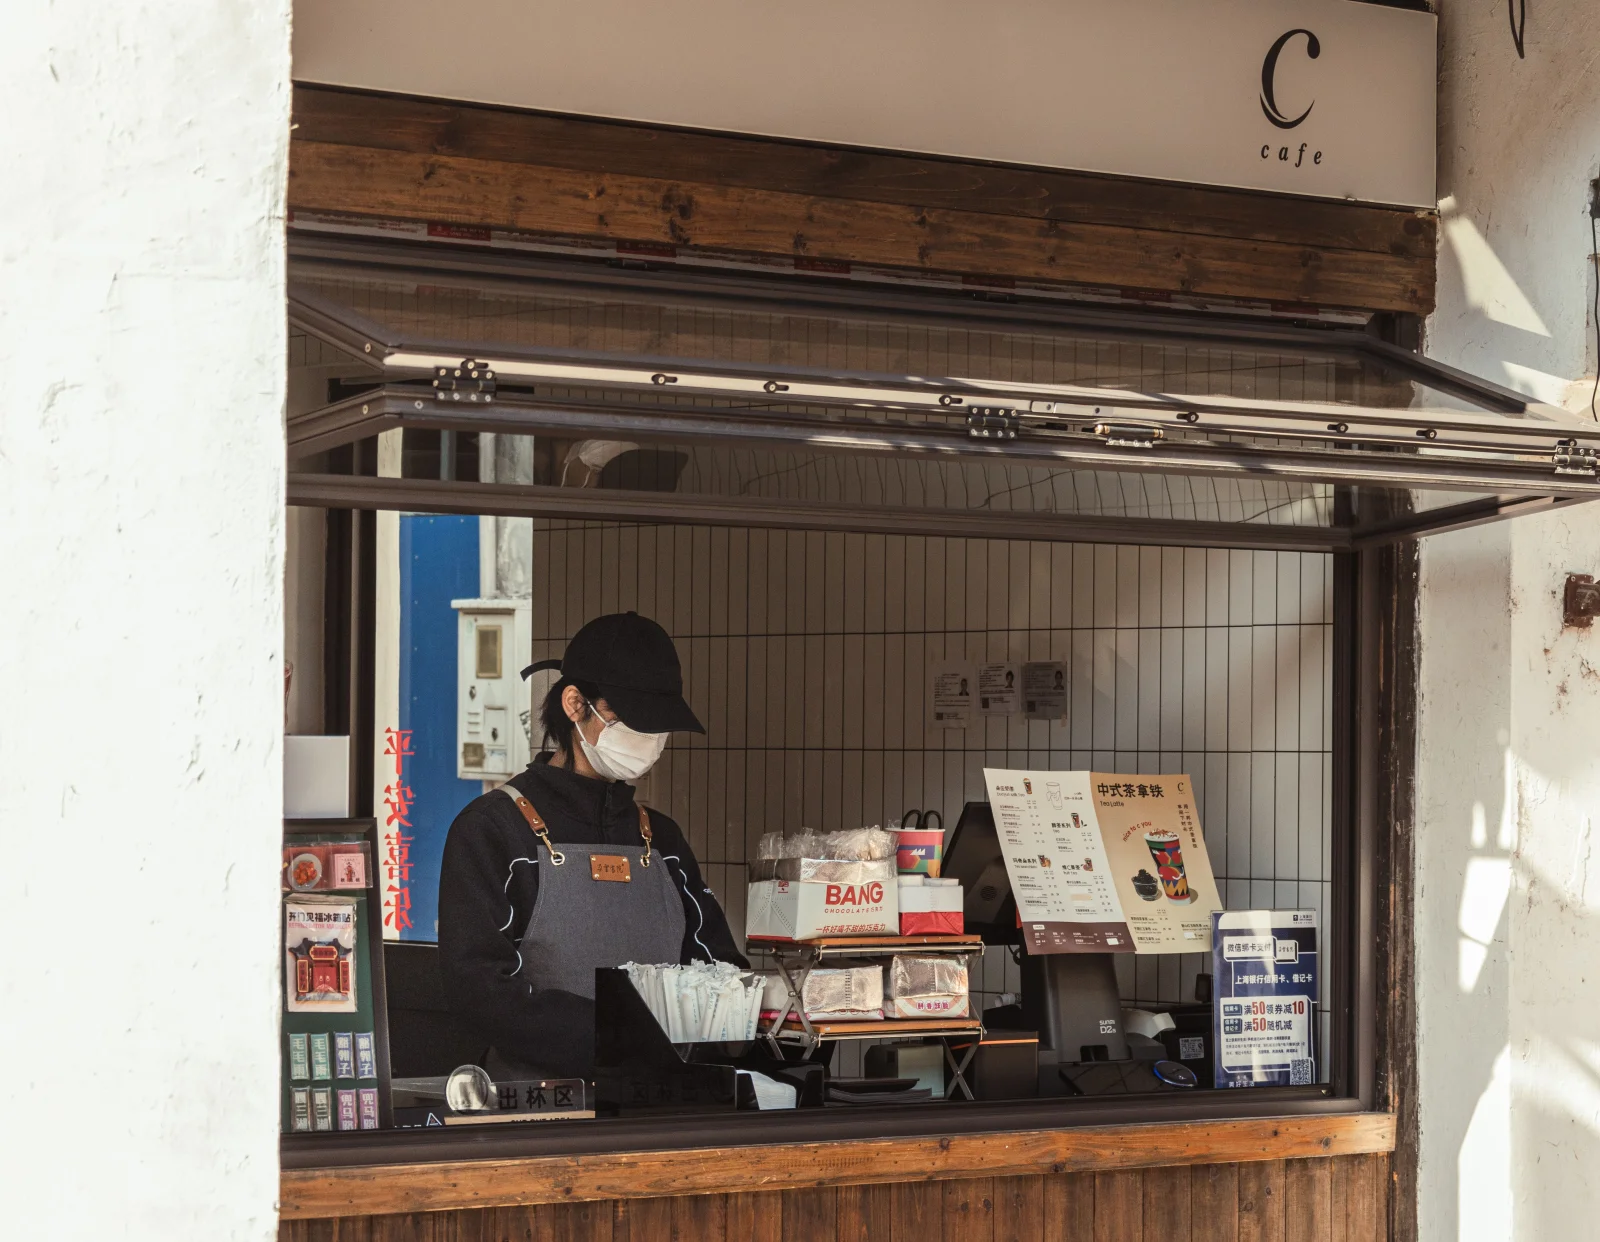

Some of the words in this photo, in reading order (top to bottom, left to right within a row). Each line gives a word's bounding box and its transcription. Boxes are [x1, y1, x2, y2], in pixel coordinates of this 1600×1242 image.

[1260, 29, 1321, 129] C
[1261, 143, 1322, 168] cafe
[1097, 783, 1164, 798] 中式茶拿铁
[1122, 830, 1132, 842] nice
[1141, 821, 1152, 829] you
[825, 882, 884, 905] BANG
[289, 912, 351, 923] 开门见福冰箱贴
[1227, 942, 1272, 953] 微信绑卡支付
[1244, 1001, 1305, 1016] 满50领券减10
[1244, 1017, 1293, 1032] 满50随机减
[293, 1037, 305, 1076] 毛毛雨
[313, 1037, 327, 1076] 毛毛雨
[500, 1085, 573, 1109] 出杯区
